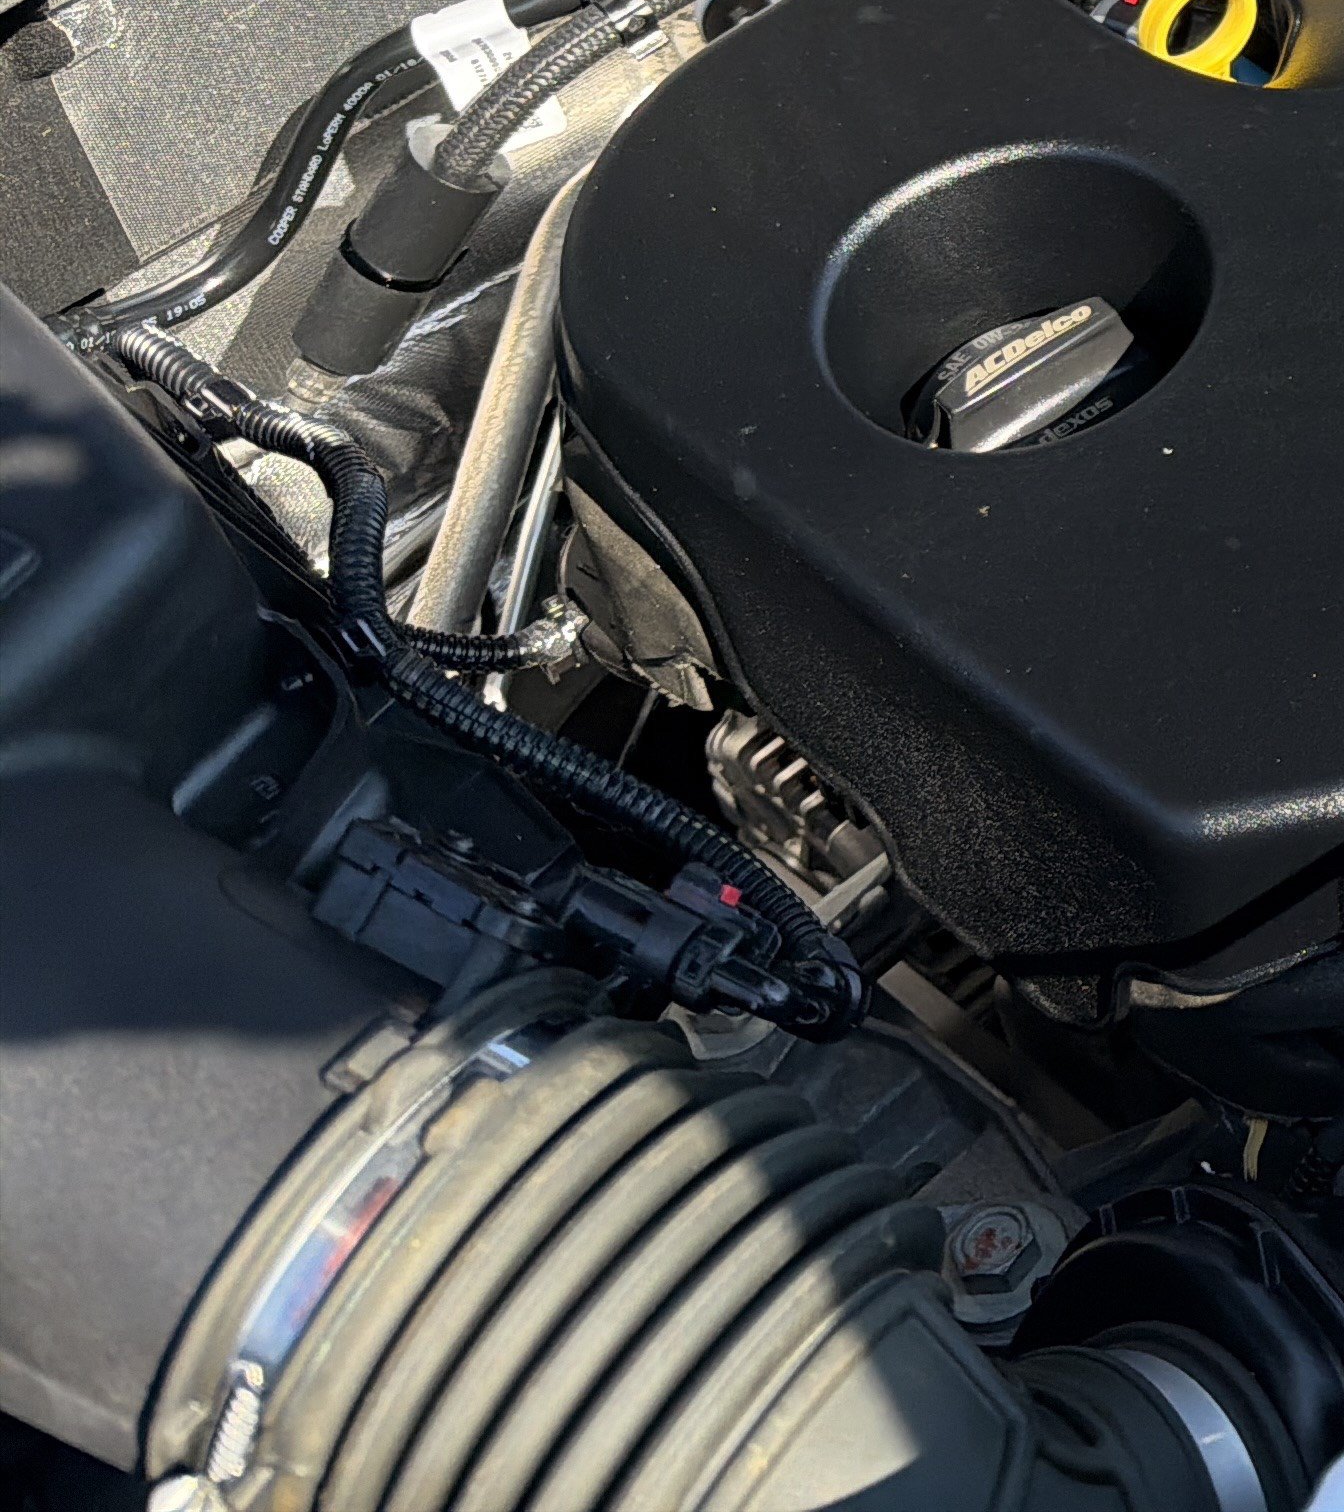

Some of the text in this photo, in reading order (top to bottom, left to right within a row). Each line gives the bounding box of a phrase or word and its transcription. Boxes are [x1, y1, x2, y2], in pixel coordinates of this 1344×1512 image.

[268, 205, 298, 245] COOPER
[292, 154, 323, 203] STANDARD
[166, 293, 207, 321] 19:05
[937, 344, 972, 382] SAE
[964, 305, 1093, 396] ACDelco
[1038, 395, 1114, 446] dexos
